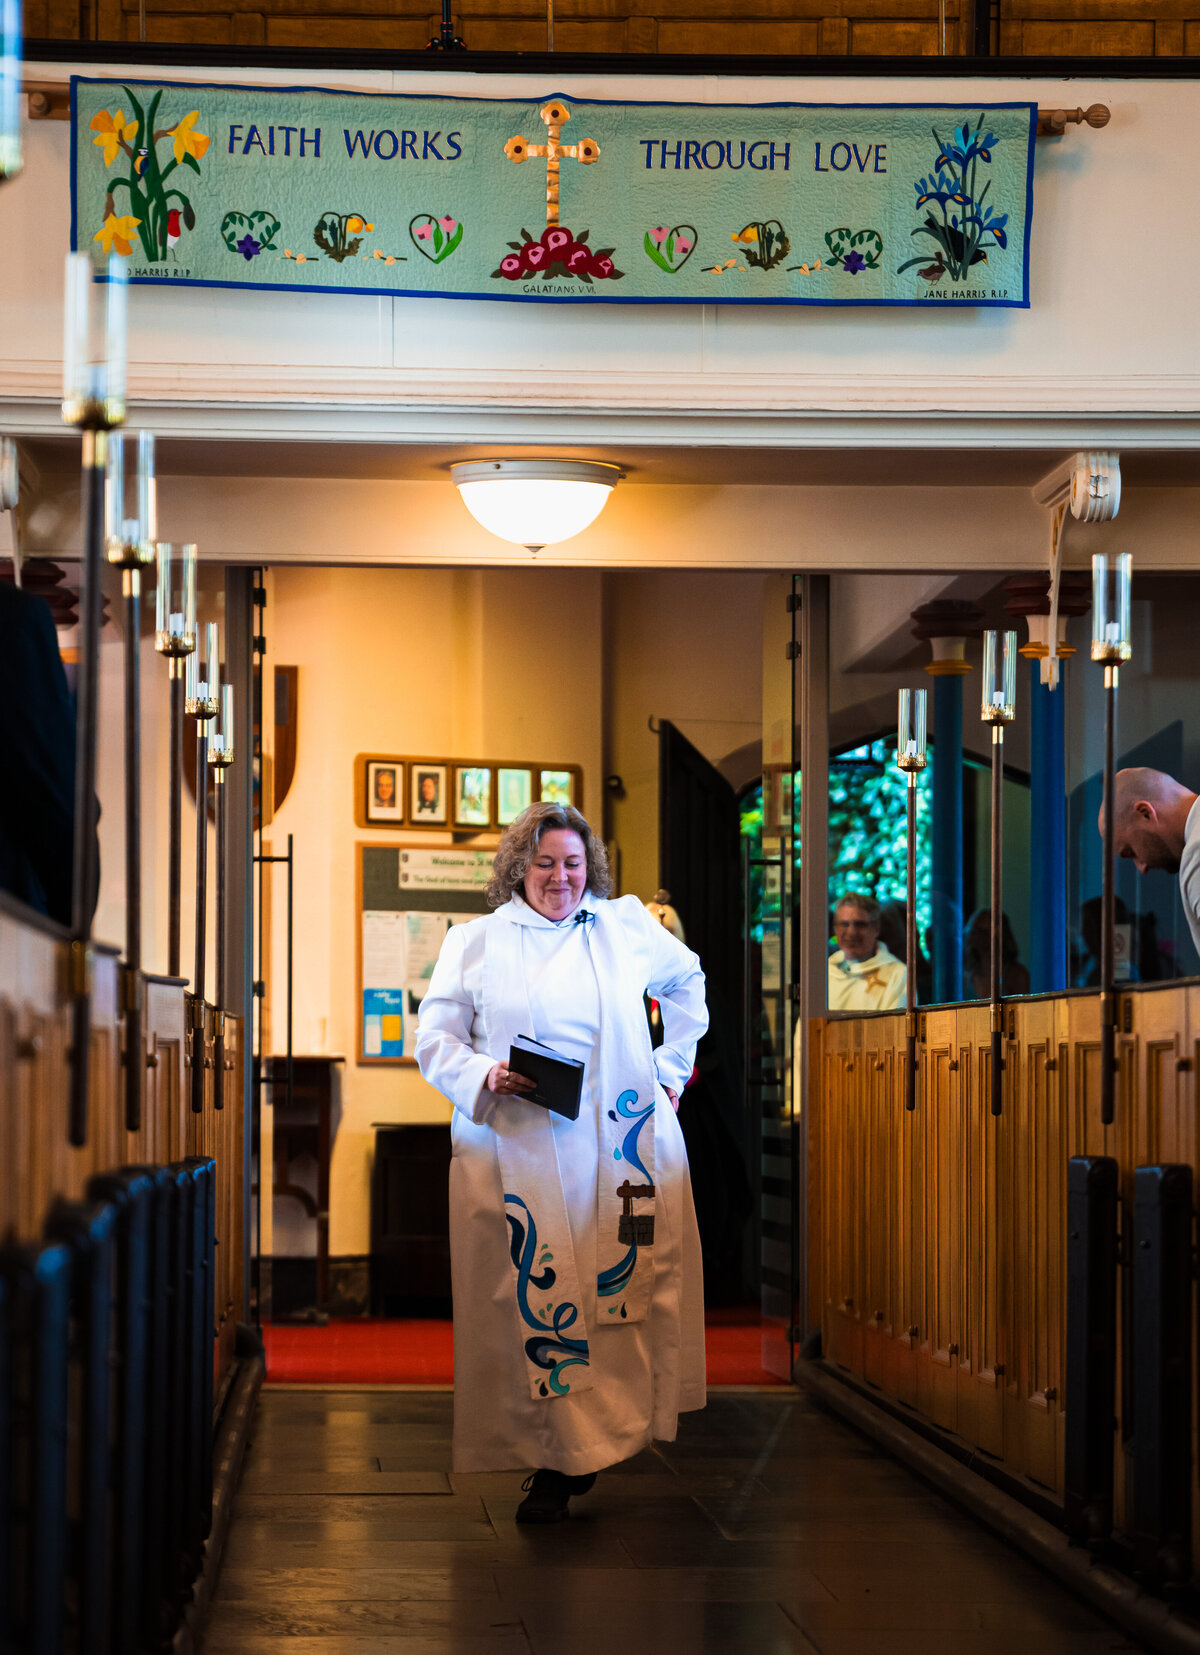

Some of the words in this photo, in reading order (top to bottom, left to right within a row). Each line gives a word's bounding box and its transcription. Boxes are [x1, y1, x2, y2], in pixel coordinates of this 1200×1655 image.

[228, 124, 321, 158] FAITH
[343, 128, 463, 160] WORKS
[639, 139, 791, 171] THROUGH
[814, 141, 887, 173] LOVE
[135, 268, 169, 277] HARRIS
[522, 284, 575, 294] GALATIANS
[924, 290, 948, 299] JANE
[952, 289, 986, 299] HARRIS
